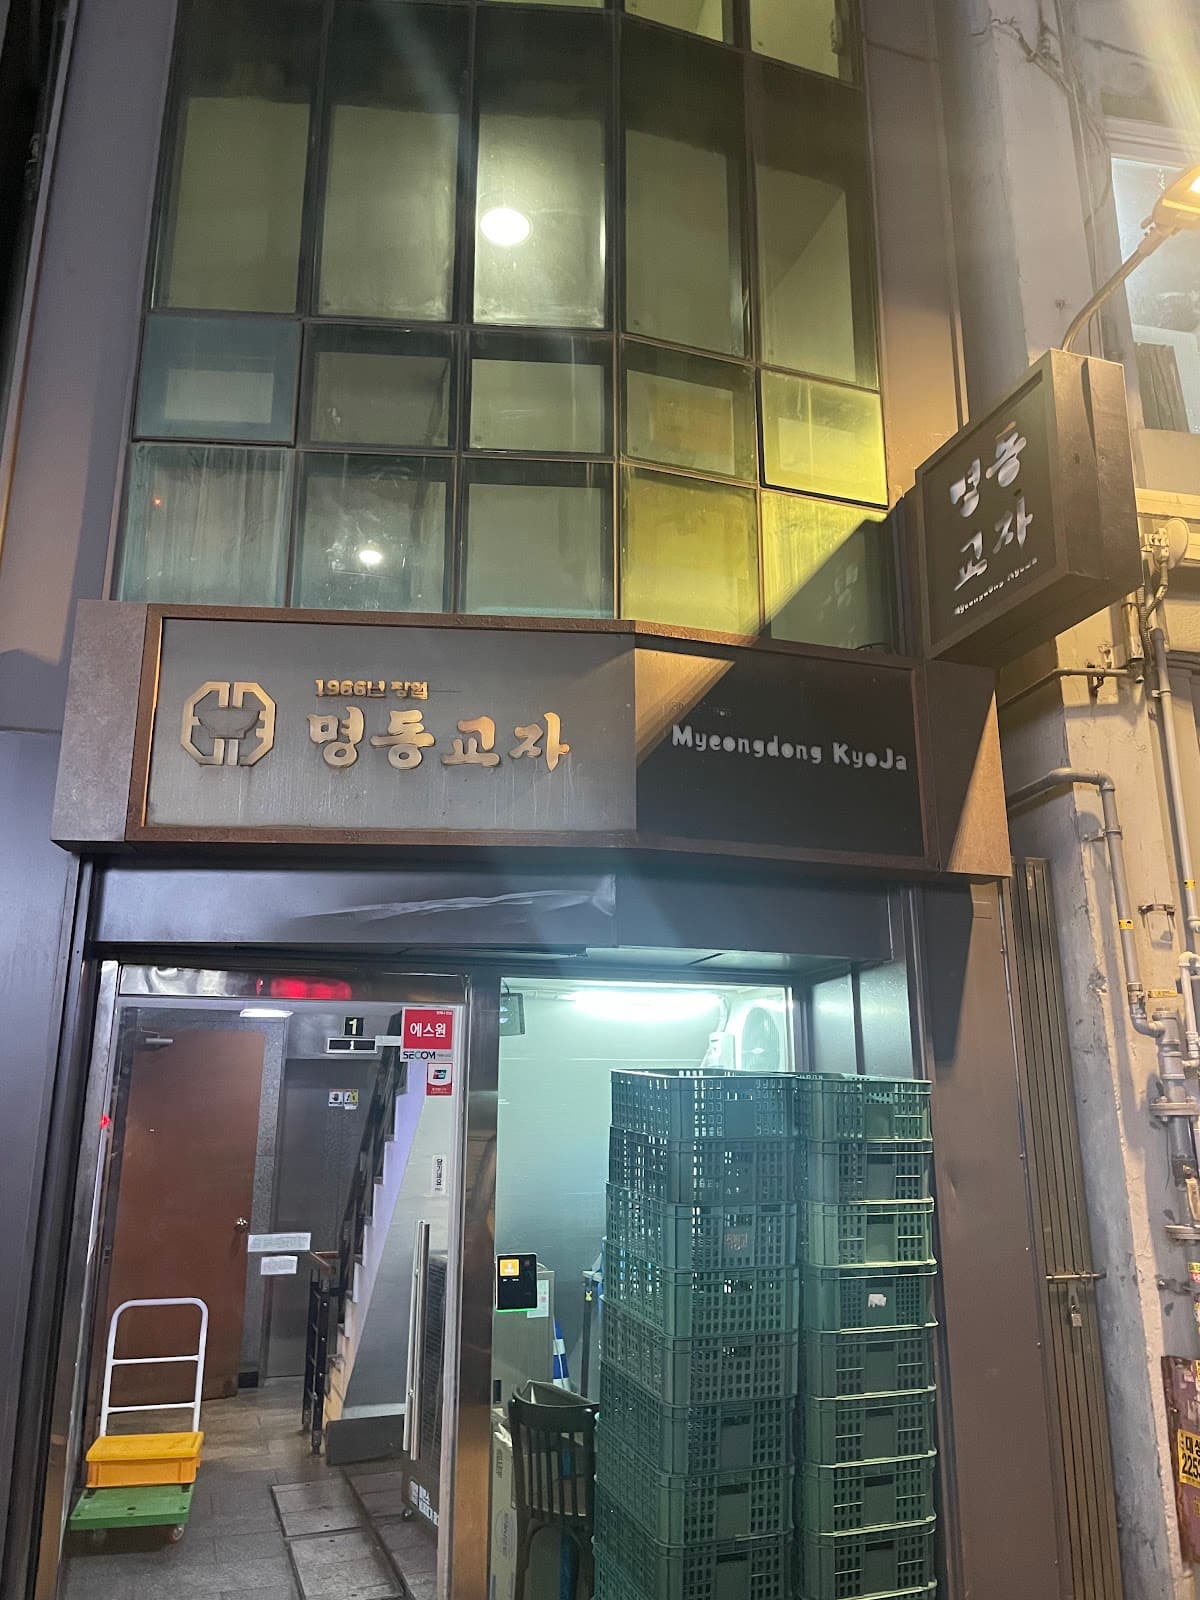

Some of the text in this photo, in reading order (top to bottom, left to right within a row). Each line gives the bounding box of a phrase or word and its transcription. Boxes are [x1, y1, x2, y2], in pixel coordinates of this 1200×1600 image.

[950, 421, 1027, 518] 명동
[953, 497, 1034, 591] 교자
[315, 679, 386, 698] 1966년
[307, 706, 570, 772] 명동교자
[672, 724, 907, 771] Myeongdong KyoJa
[349, 1018, 358, 1035] 1
[410, 1022, 446, 1038] 에스원
[350, 1040, 355, 1050] 1
[403, 1051, 436, 1060] SECOM
